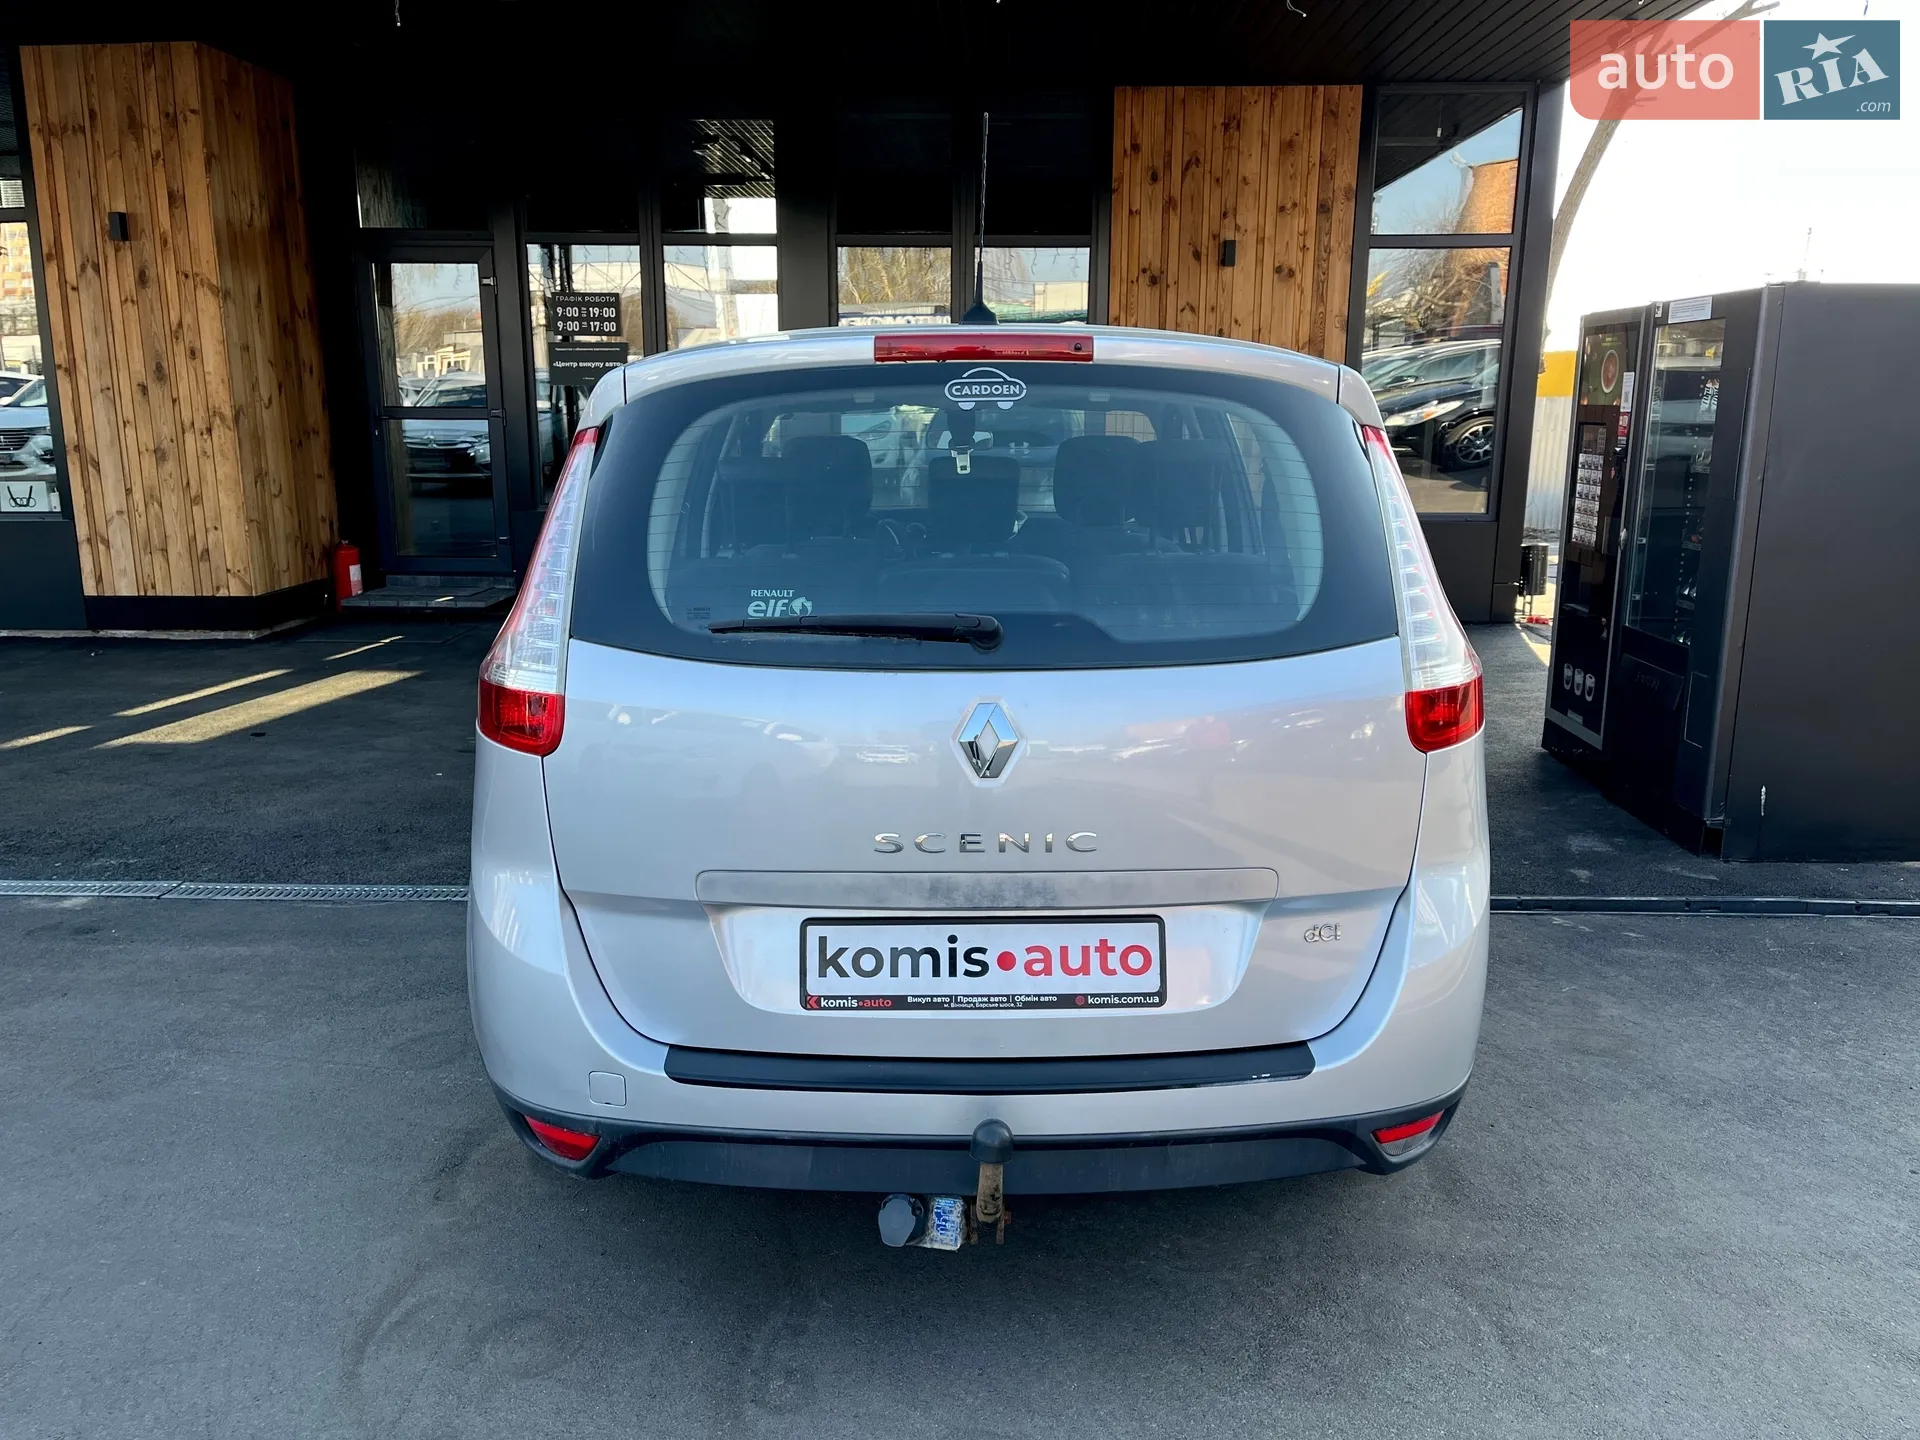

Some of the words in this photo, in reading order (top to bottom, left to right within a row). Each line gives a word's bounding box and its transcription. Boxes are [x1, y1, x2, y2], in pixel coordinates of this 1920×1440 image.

[556, 307, 579, 317] 9:00
[588, 307, 616, 318] 19:00
[557, 320, 580, 331] 9:00
[589, 321, 617, 332] 17:00
[951, 385, 1020, 396] CARDOEN
[748, 600, 788, 617] elf
[873, 831, 1098, 854] SCENIC
[907, 996, 931, 1004] Викуп
[957, 996, 989, 1004] Продаж
[1087, 994, 1160, 1005] komis.com.ua
